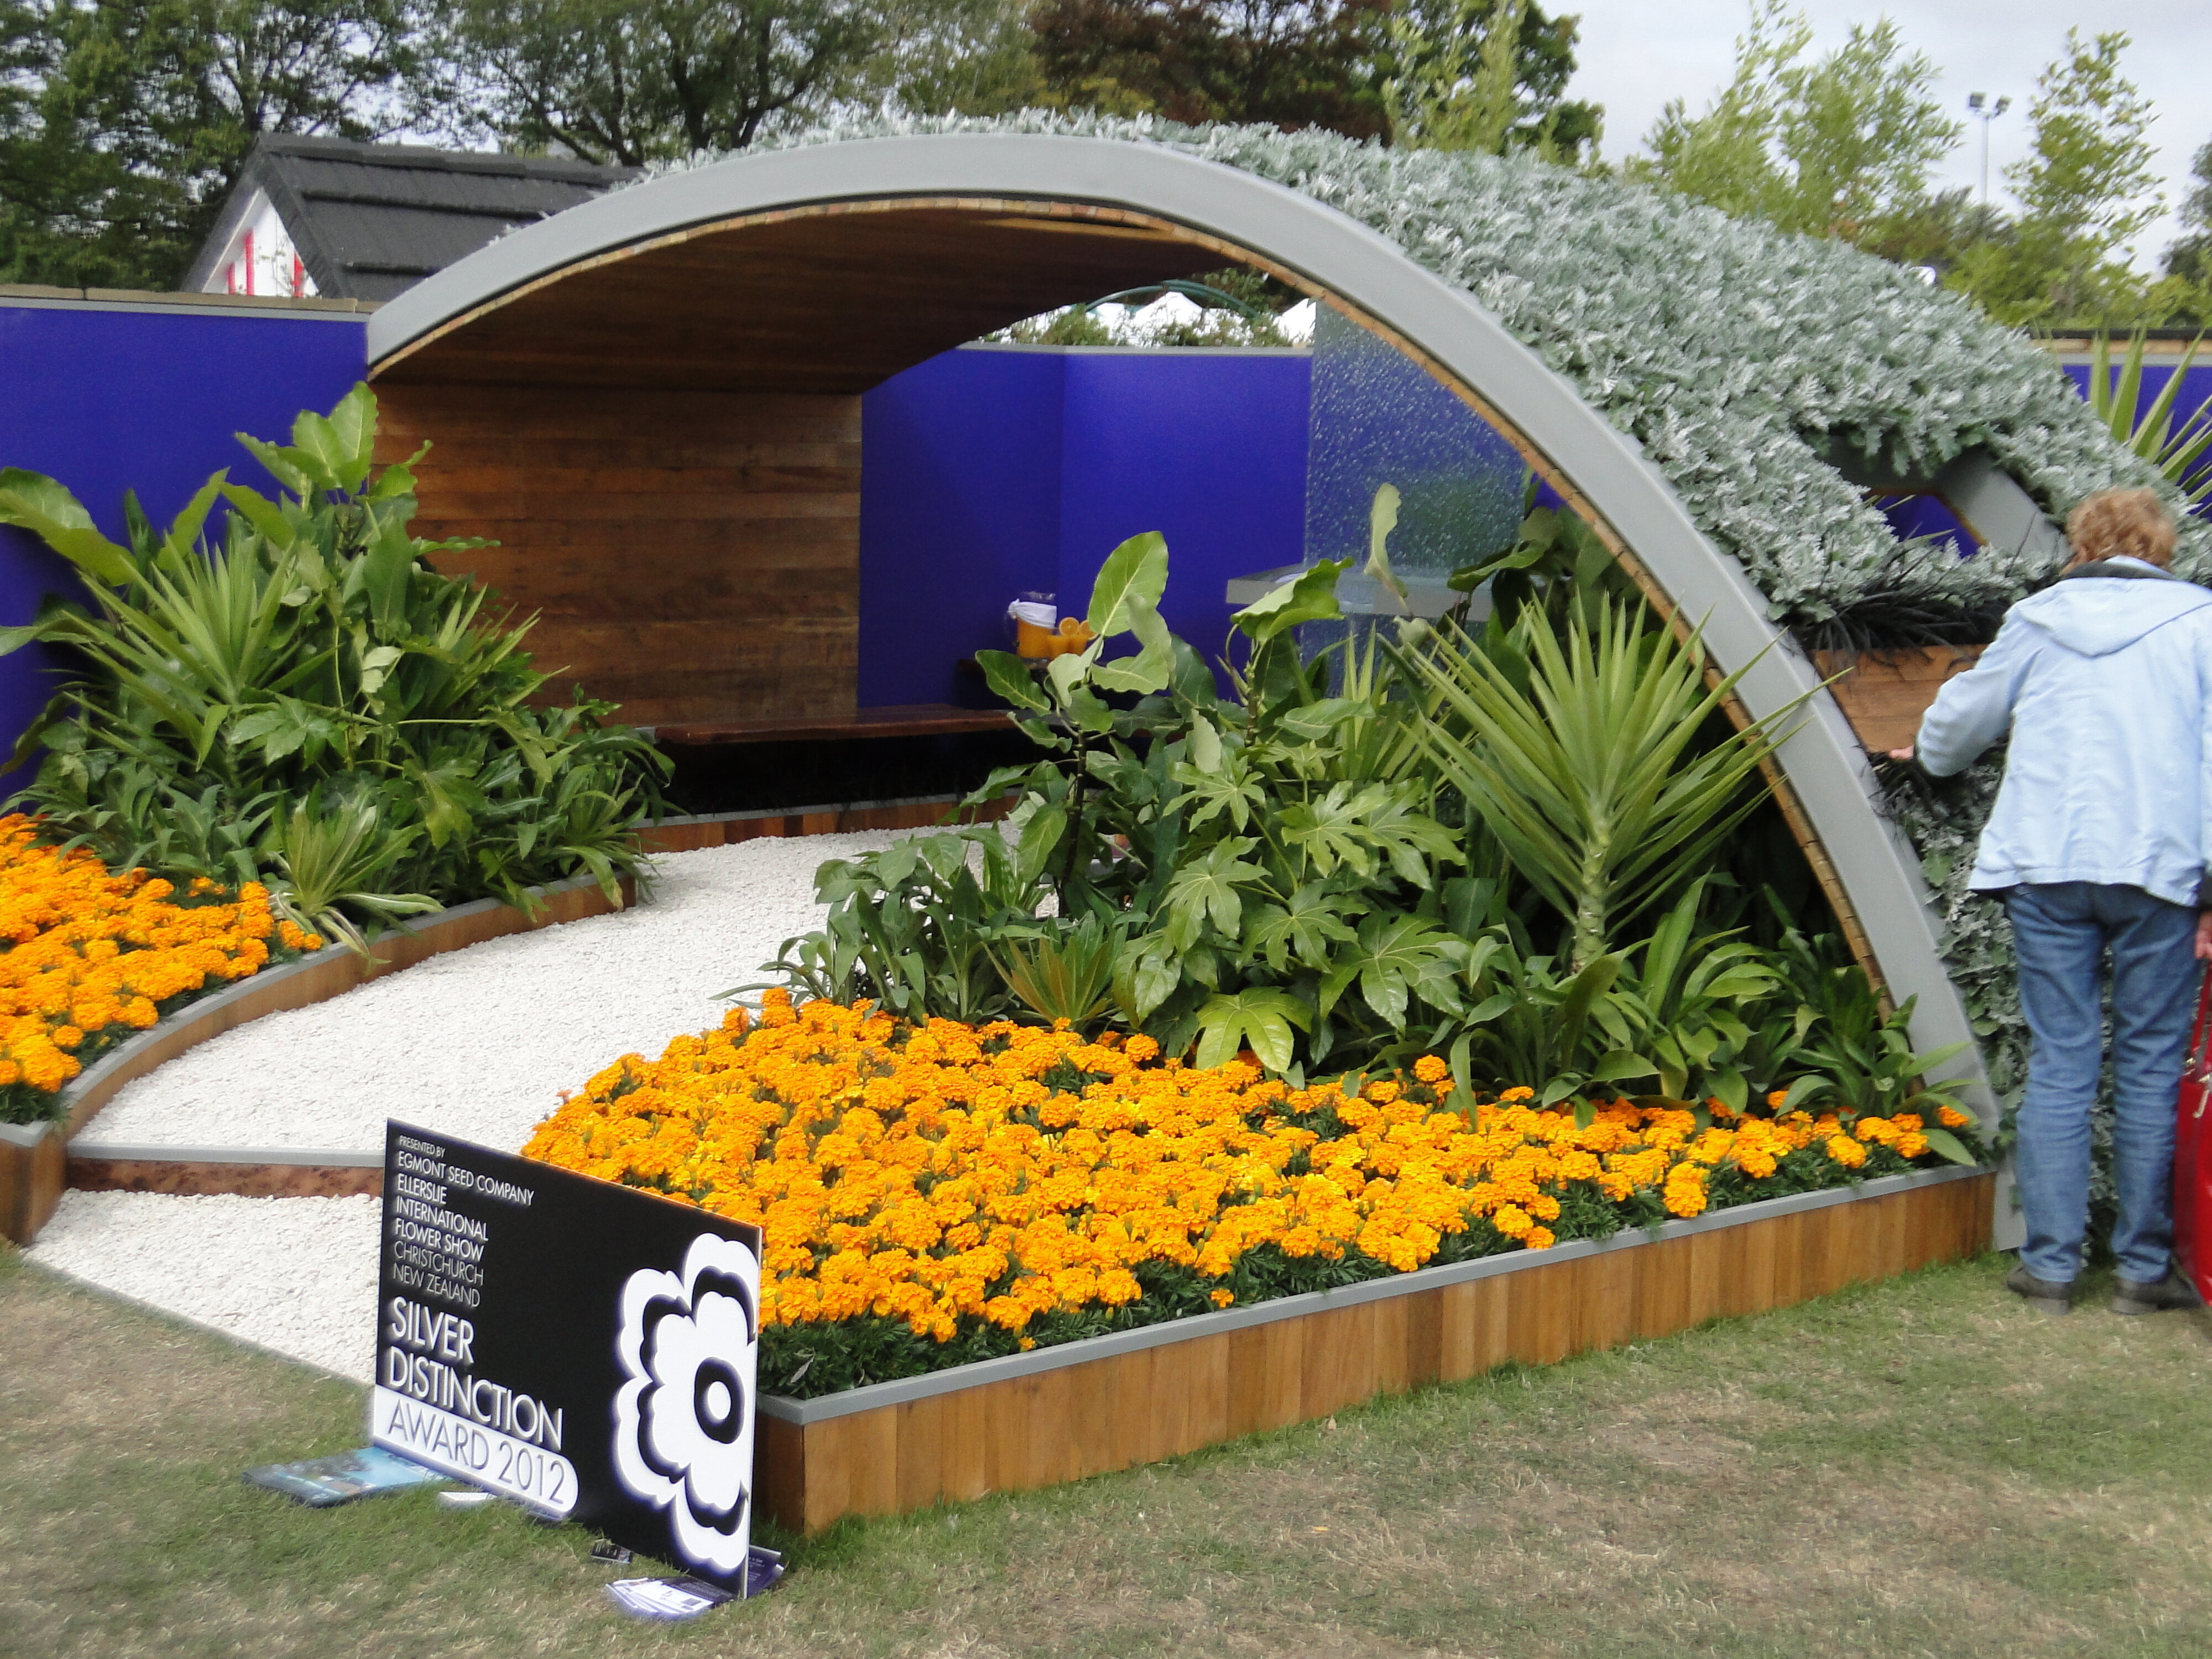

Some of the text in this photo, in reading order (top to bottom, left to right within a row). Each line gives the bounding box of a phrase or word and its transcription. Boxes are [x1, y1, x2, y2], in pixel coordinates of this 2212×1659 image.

[399, 1135, 446, 1158] PRESENTED BY
[398, 1150, 534, 1206] EGMONT SEED COMPANY
[398, 1173, 447, 1205] ELLERSLIE
[395, 1218, 484, 1262] FLOWER SHOW
[397, 1195, 489, 1241] INTERNATIONAL
[393, 1262, 480, 1308] NEW ZEALAND
[394, 1241, 484, 1286] CHRISTCHURCH
[392, 1296, 474, 1364] SILVER
[390, 1345, 563, 1451] DISTINCTION
[388, 1399, 565, 1504] AWARD 2012
